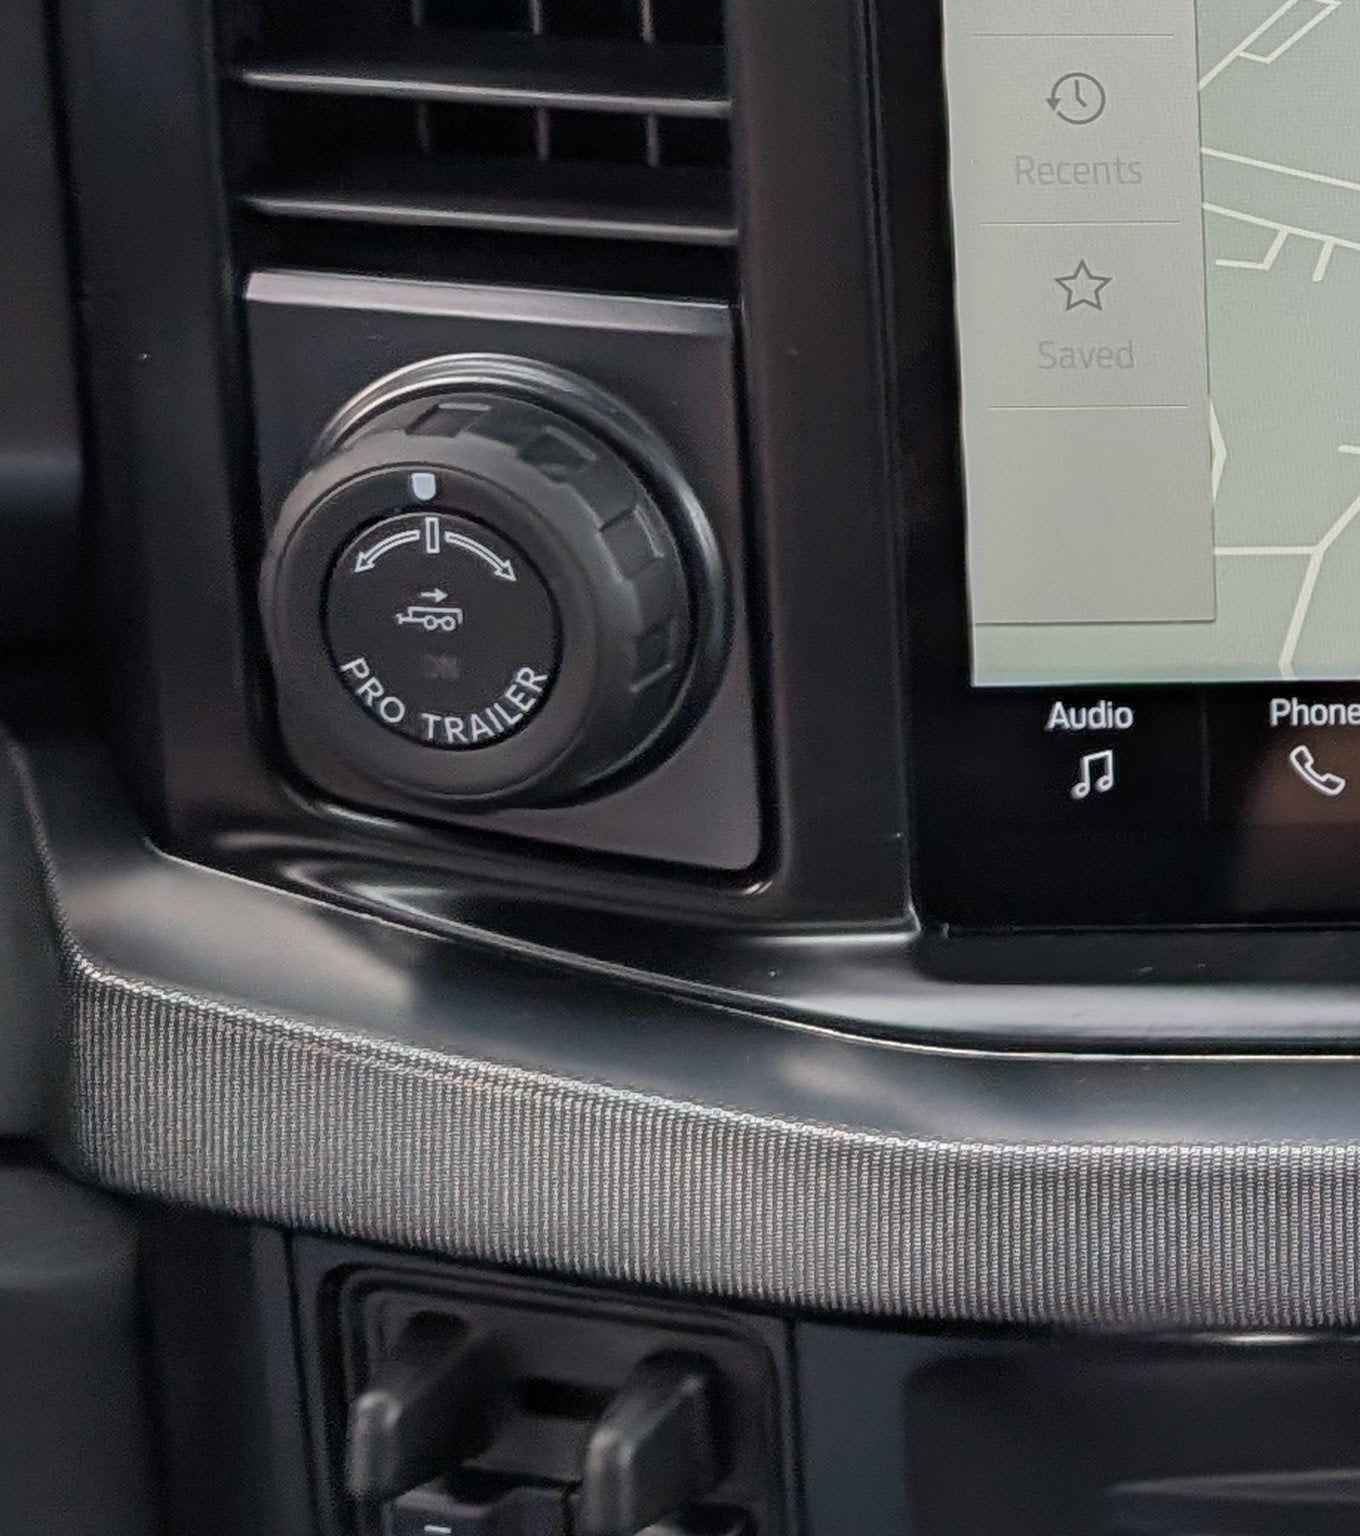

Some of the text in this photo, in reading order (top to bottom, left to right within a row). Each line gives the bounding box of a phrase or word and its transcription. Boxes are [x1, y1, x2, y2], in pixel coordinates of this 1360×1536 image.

[1015, 154, 1142, 186] Recents
[1038, 338, 1135, 370] Saved
[341, 657, 548, 743] PRO TRAILER
[1048, 700, 1133, 730] Audio
